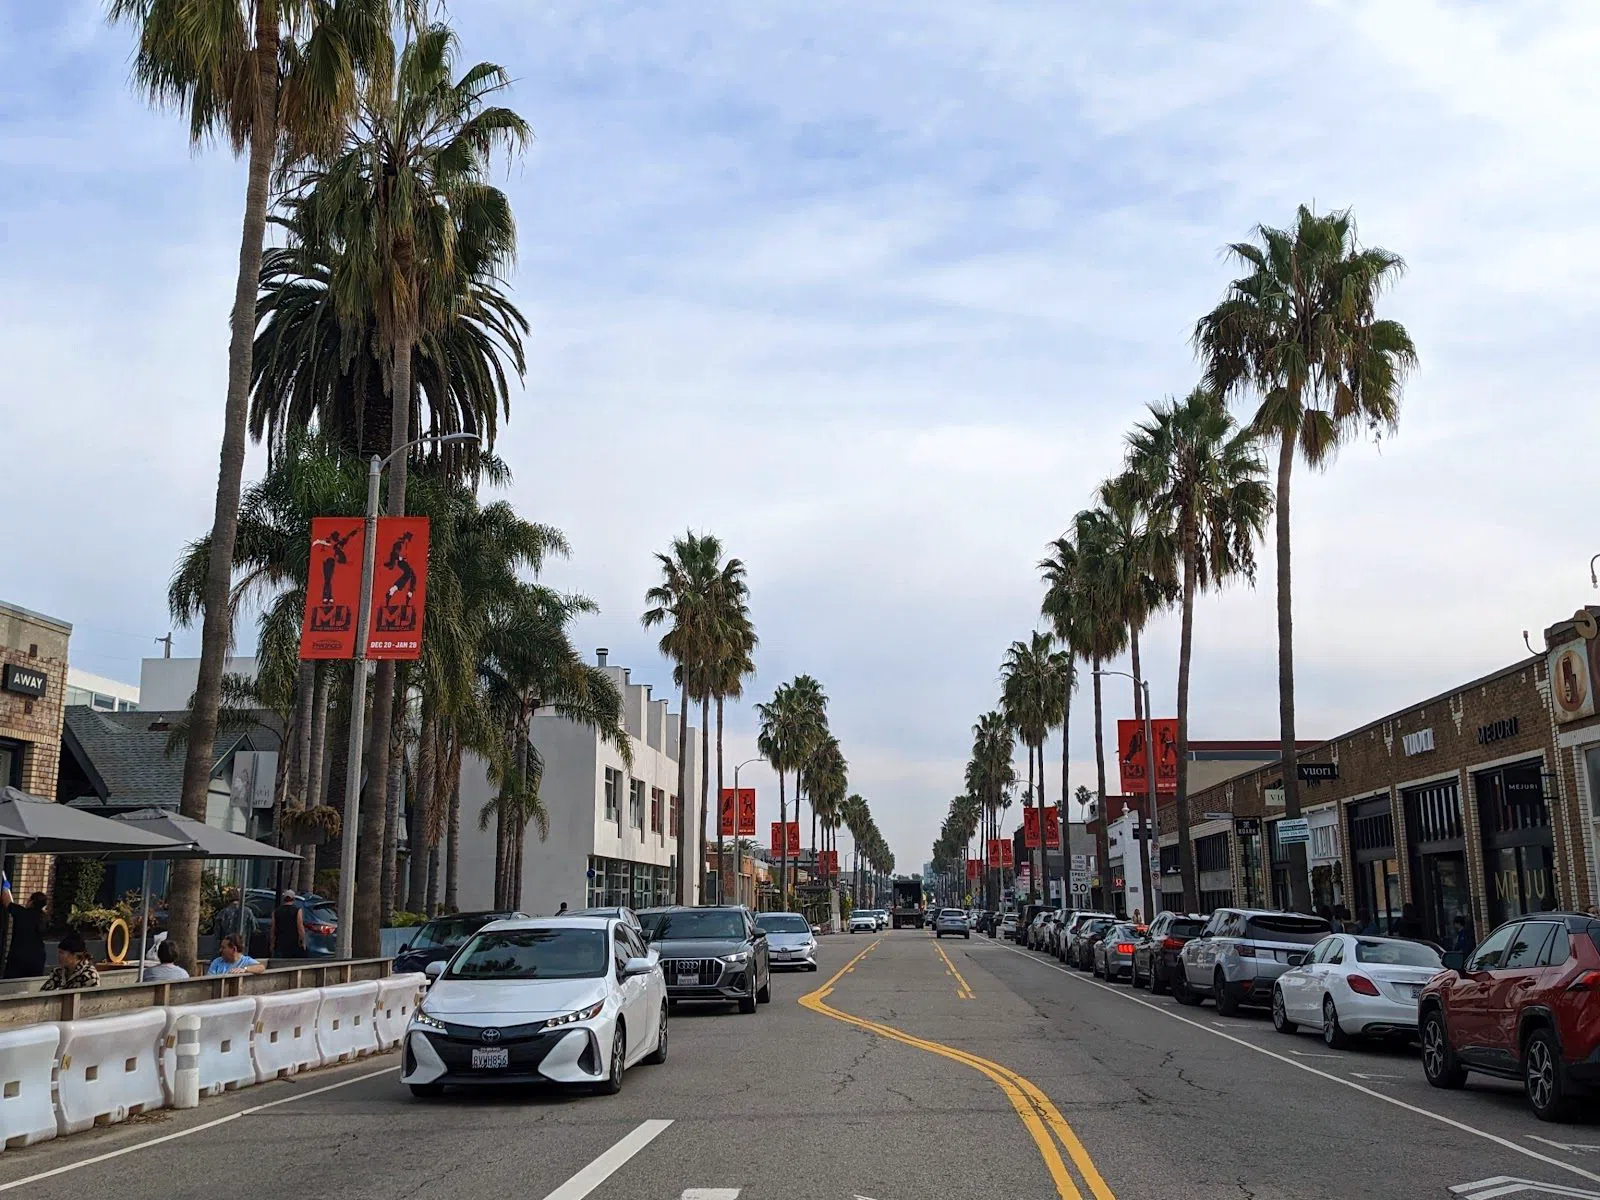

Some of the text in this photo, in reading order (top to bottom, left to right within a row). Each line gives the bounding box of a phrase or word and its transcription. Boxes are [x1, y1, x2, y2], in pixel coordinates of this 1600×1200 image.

[13, 672, 43, 689] AWAY
[1477, 717, 1519, 745] MEJURI
[1072, 883, 1087, 892] 30
